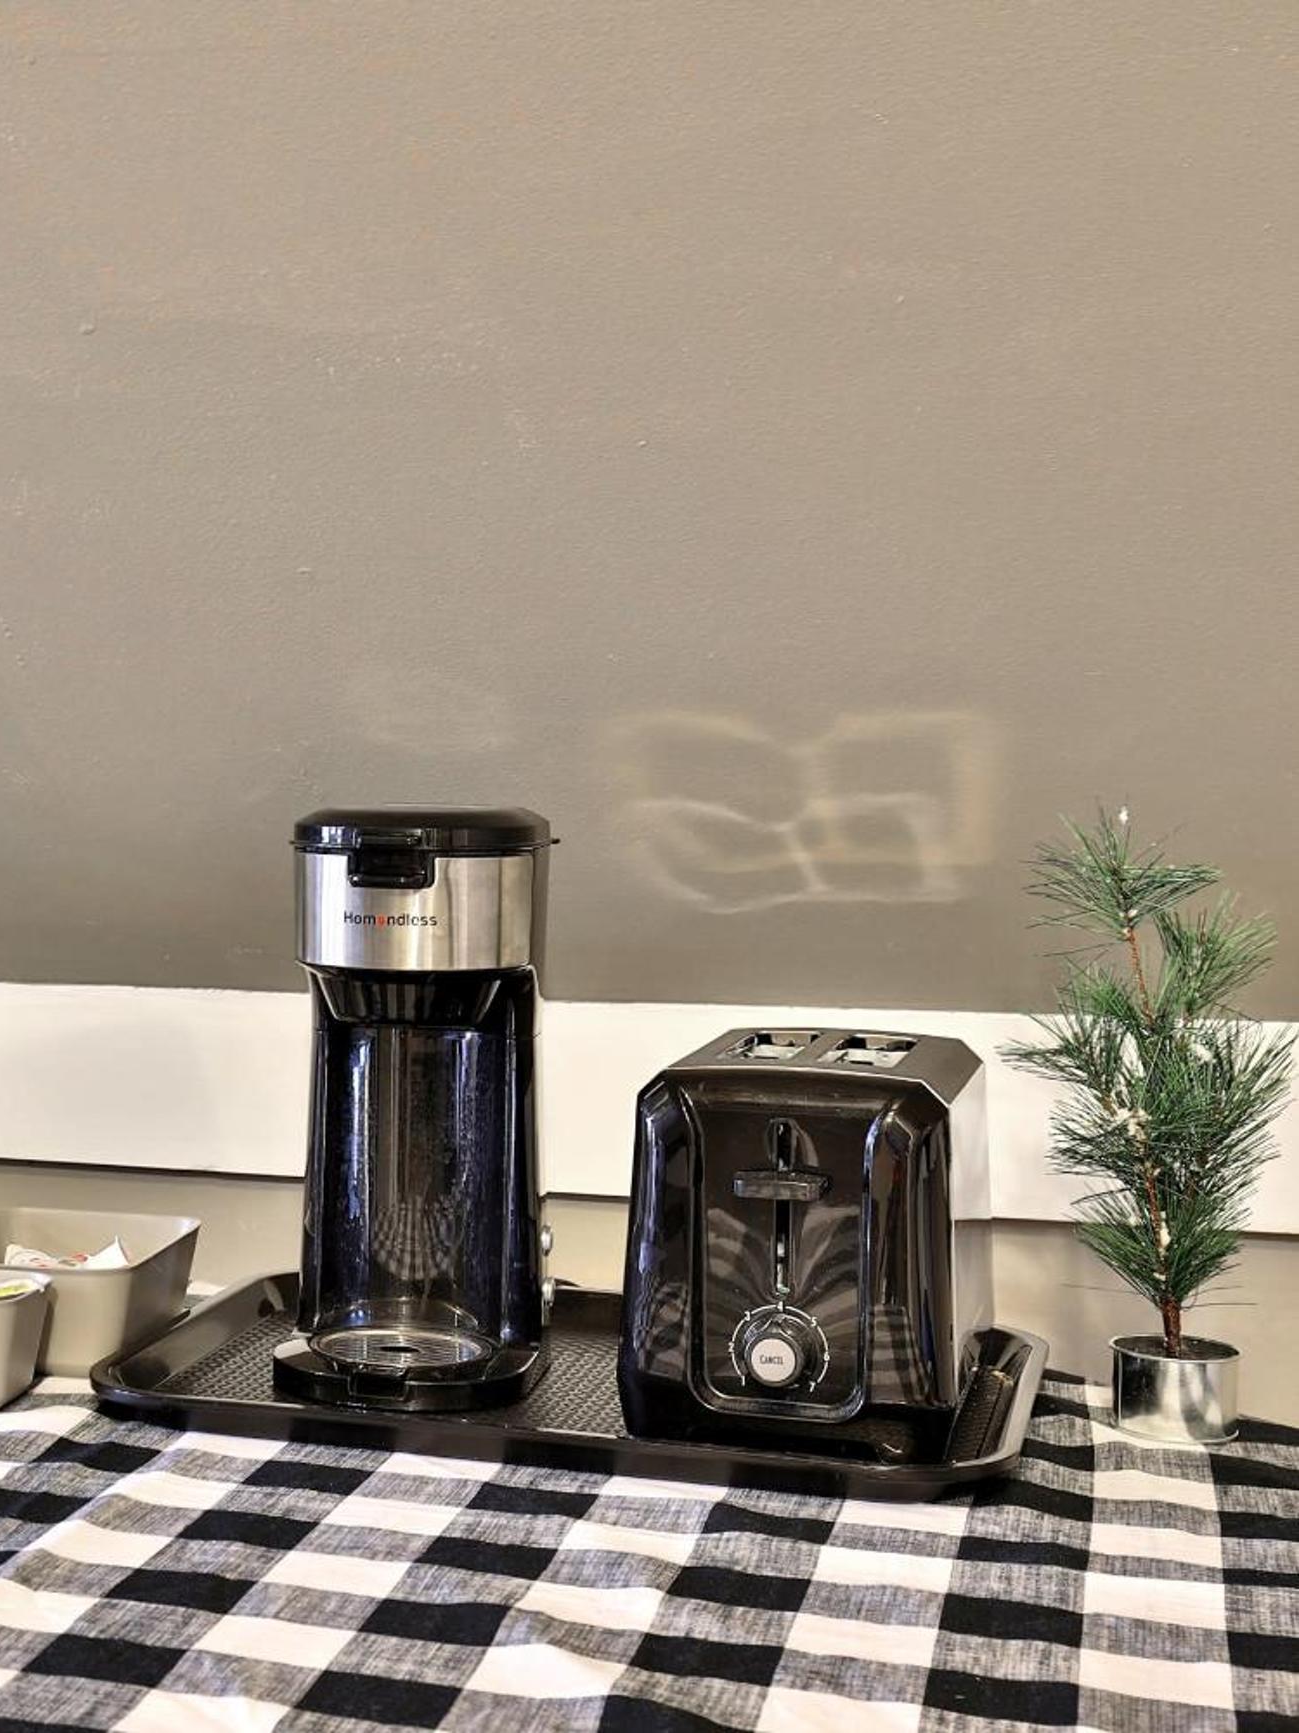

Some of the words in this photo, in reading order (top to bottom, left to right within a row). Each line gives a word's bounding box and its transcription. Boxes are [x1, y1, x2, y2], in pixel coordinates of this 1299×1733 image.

[776, 1301, 784, 1312] 4
[809, 1316, 818, 1327] 5
[728, 1342, 735, 1353] 2
[823, 1351, 831, 1361] 6
[741, 1375, 746, 1387] 1
[809, 1381, 817, 1392] 7
